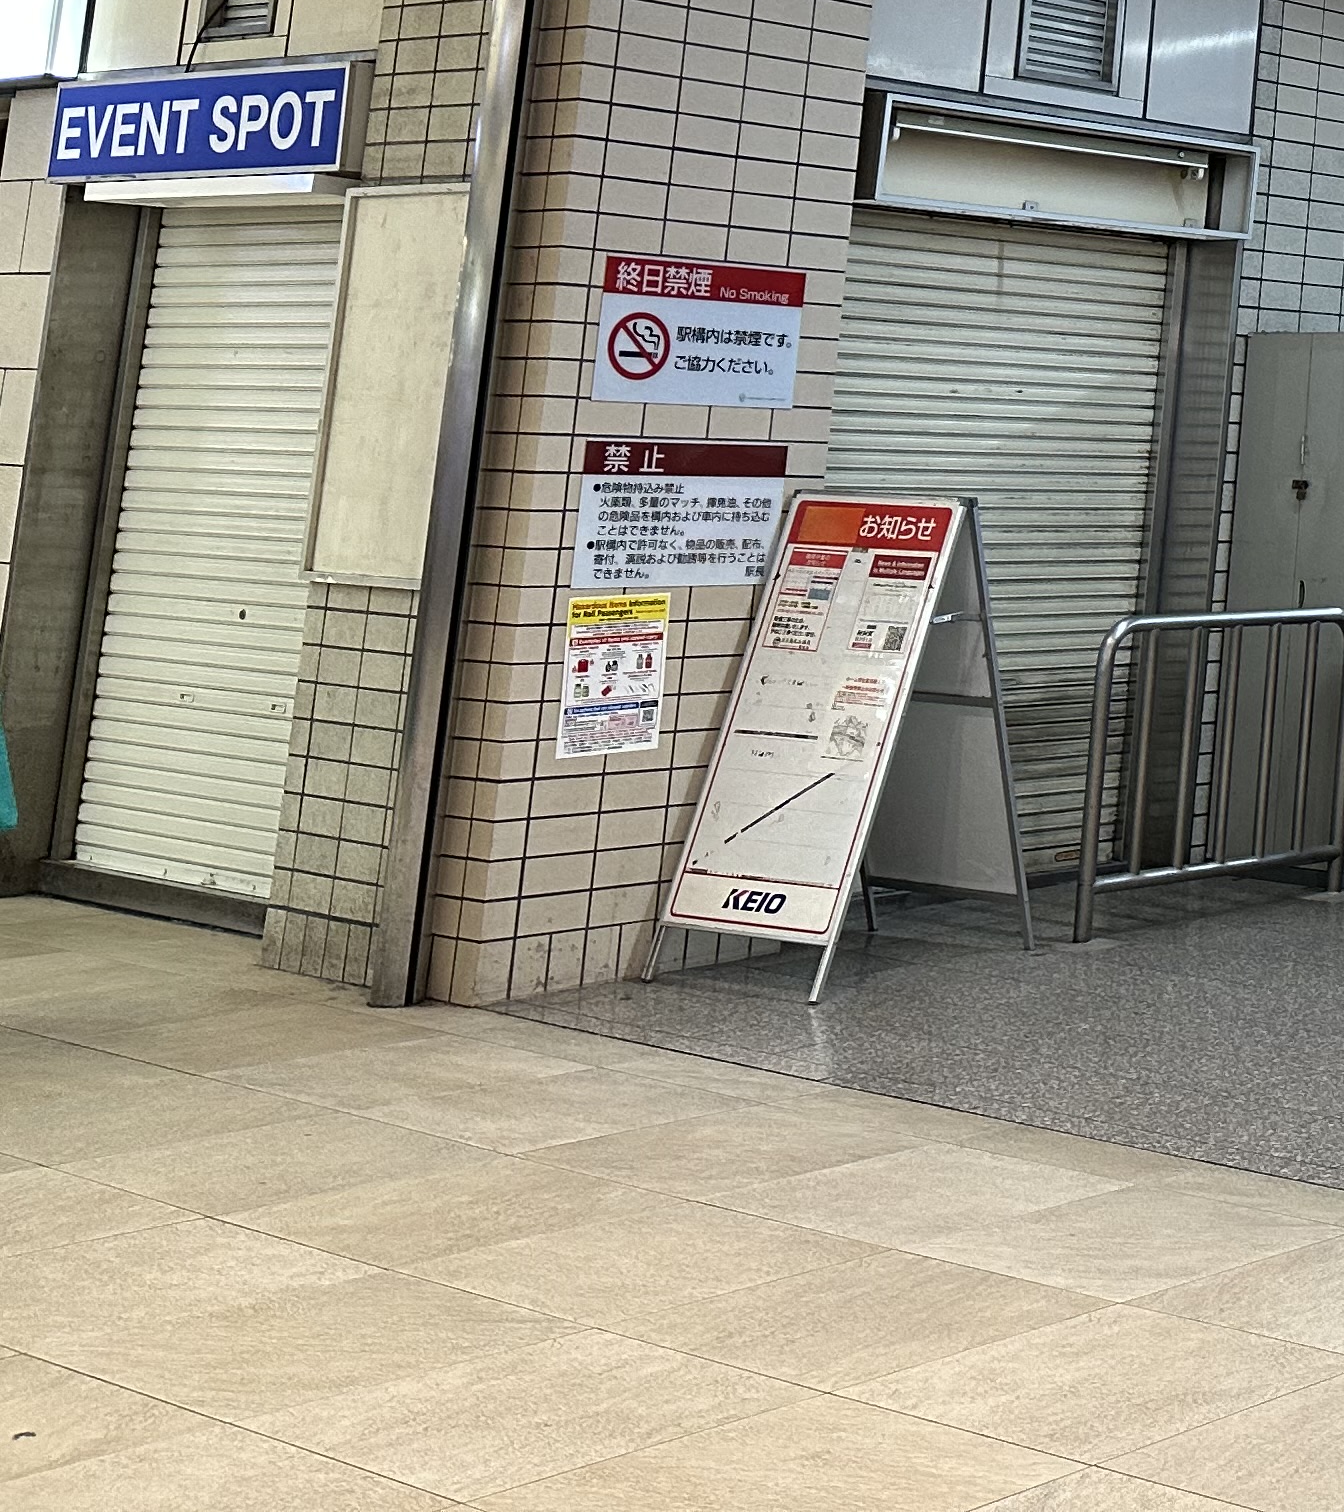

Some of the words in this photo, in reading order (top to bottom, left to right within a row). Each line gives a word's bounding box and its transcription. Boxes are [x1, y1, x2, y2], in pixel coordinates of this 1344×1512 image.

[56, 99, 199, 160] EVENT
[209, 89, 336, 154] SPOT
[616, 262, 713, 297] 終日禁煙
[720, 286, 736, 299] No
[739, 288, 789, 304] Smoking
[676, 326, 792, 348] 駅構内は禁煙です。
[674, 355, 773, 375] ご協力ください。
[859, 514, 936, 540] お知らせ
[722, 888, 786, 914] KEIO
